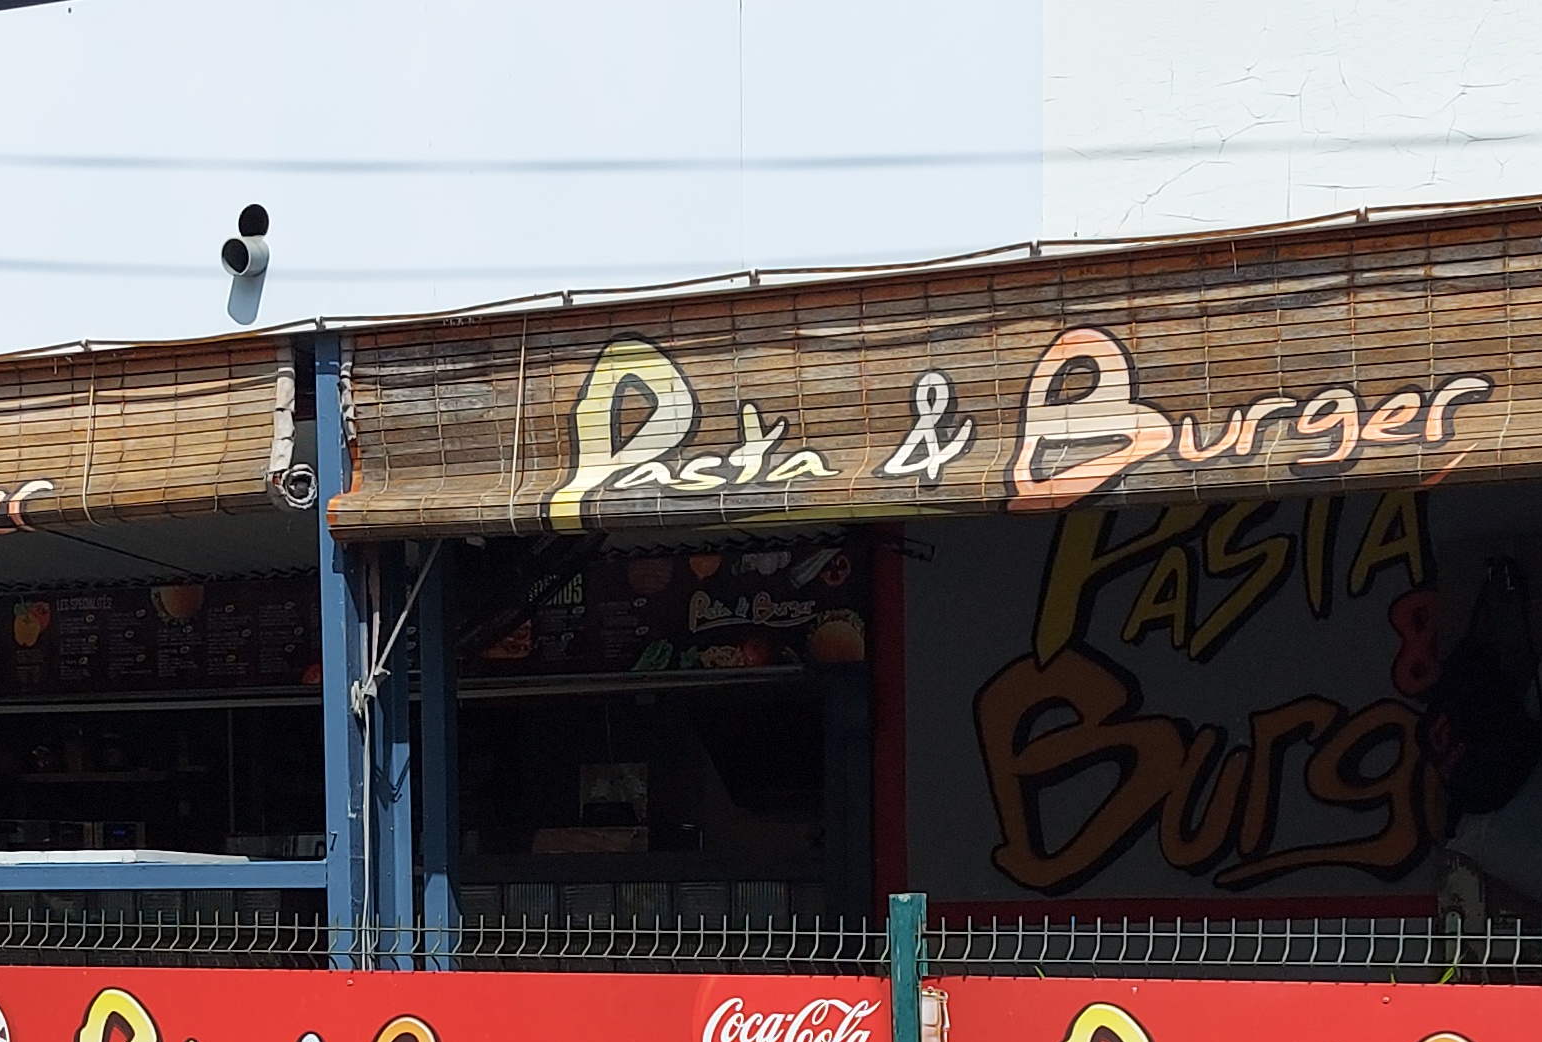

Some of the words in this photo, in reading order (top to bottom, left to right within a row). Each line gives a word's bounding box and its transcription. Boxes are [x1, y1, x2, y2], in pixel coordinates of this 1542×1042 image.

[546, 334, 840, 531] Pasta
[873, 369, 972, 485] &
[1004, 326, 1493, 514] Burger
